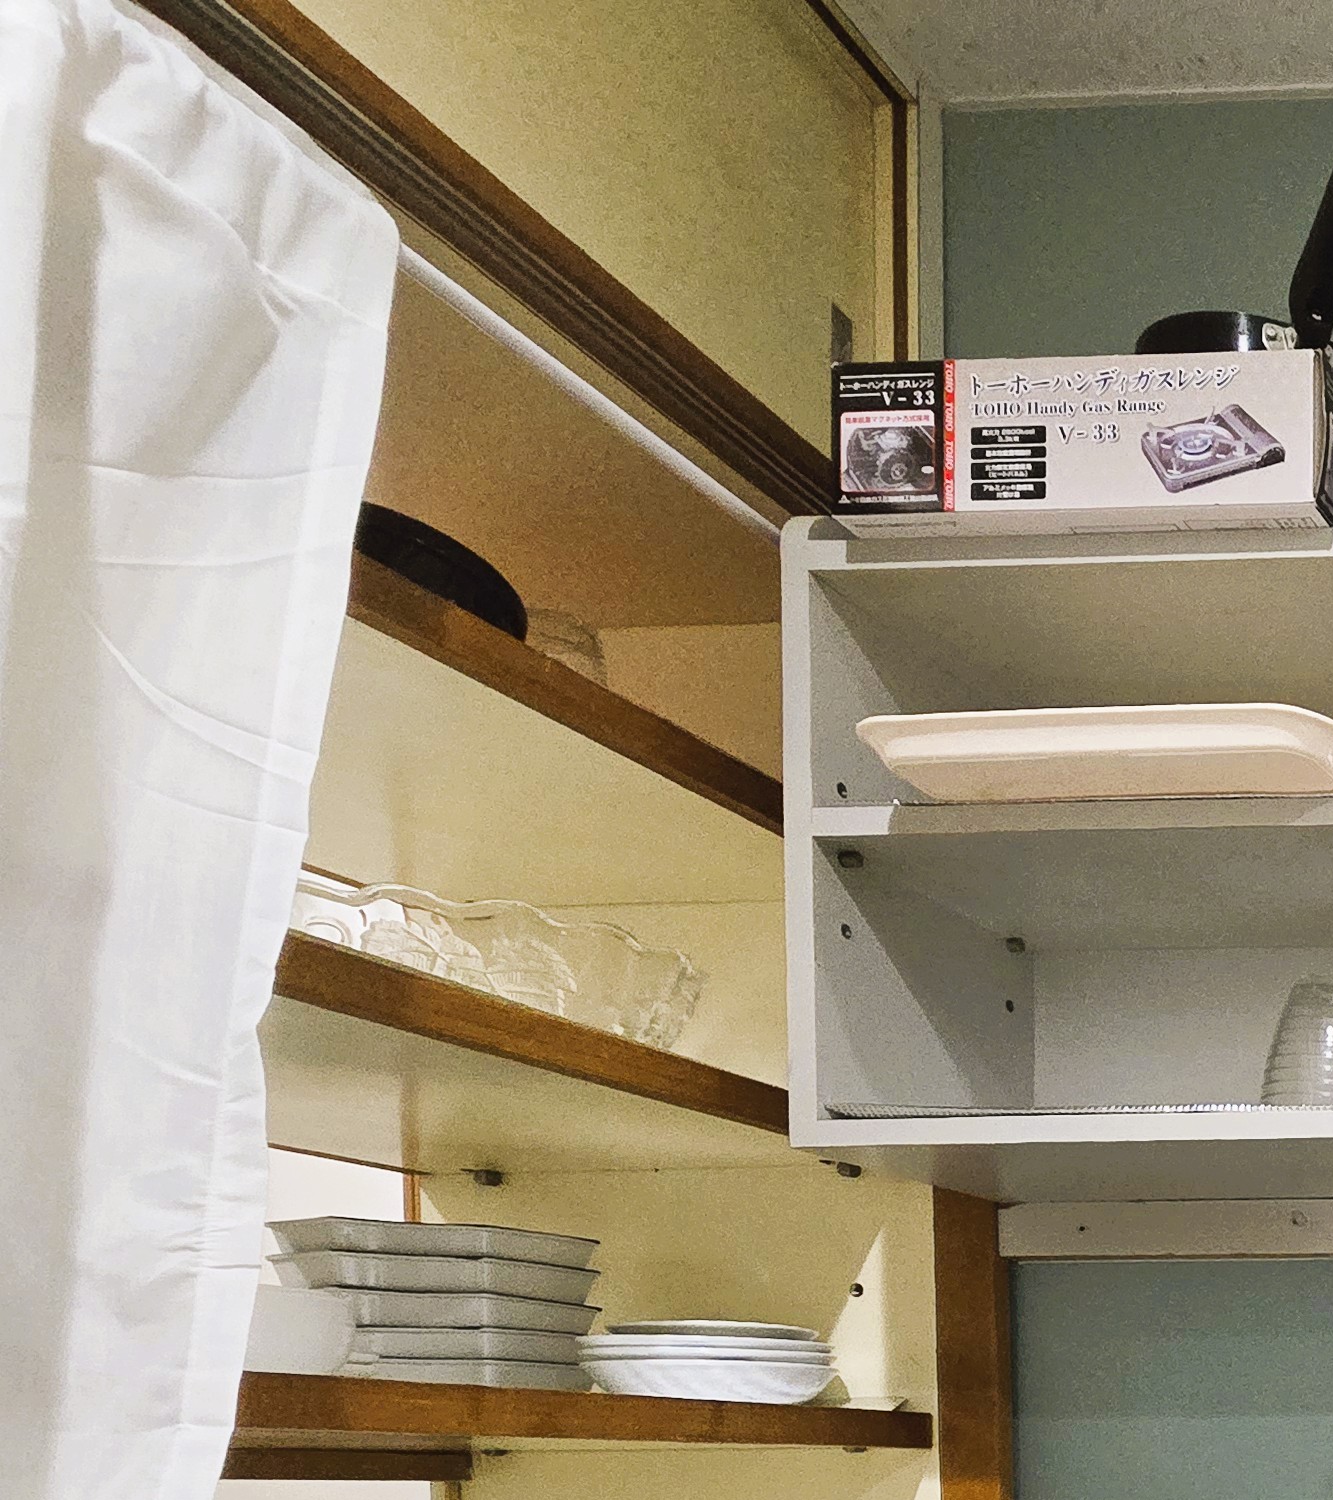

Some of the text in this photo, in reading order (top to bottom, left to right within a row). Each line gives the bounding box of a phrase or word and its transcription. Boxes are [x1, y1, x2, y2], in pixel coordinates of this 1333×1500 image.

[839, 378, 935, 391] トーホーハンディガスレンジ
[943, 362, 955, 394] TOHO
[970, 365, 1240, 398] トーホーハンディガスレンジ
[943, 402, 955, 433] TOHO
[971, 398, 1166, 419] TOHO Handy Gas Range
[943, 440, 955, 471] TOHO
[943, 478, 955, 510] TOHO
